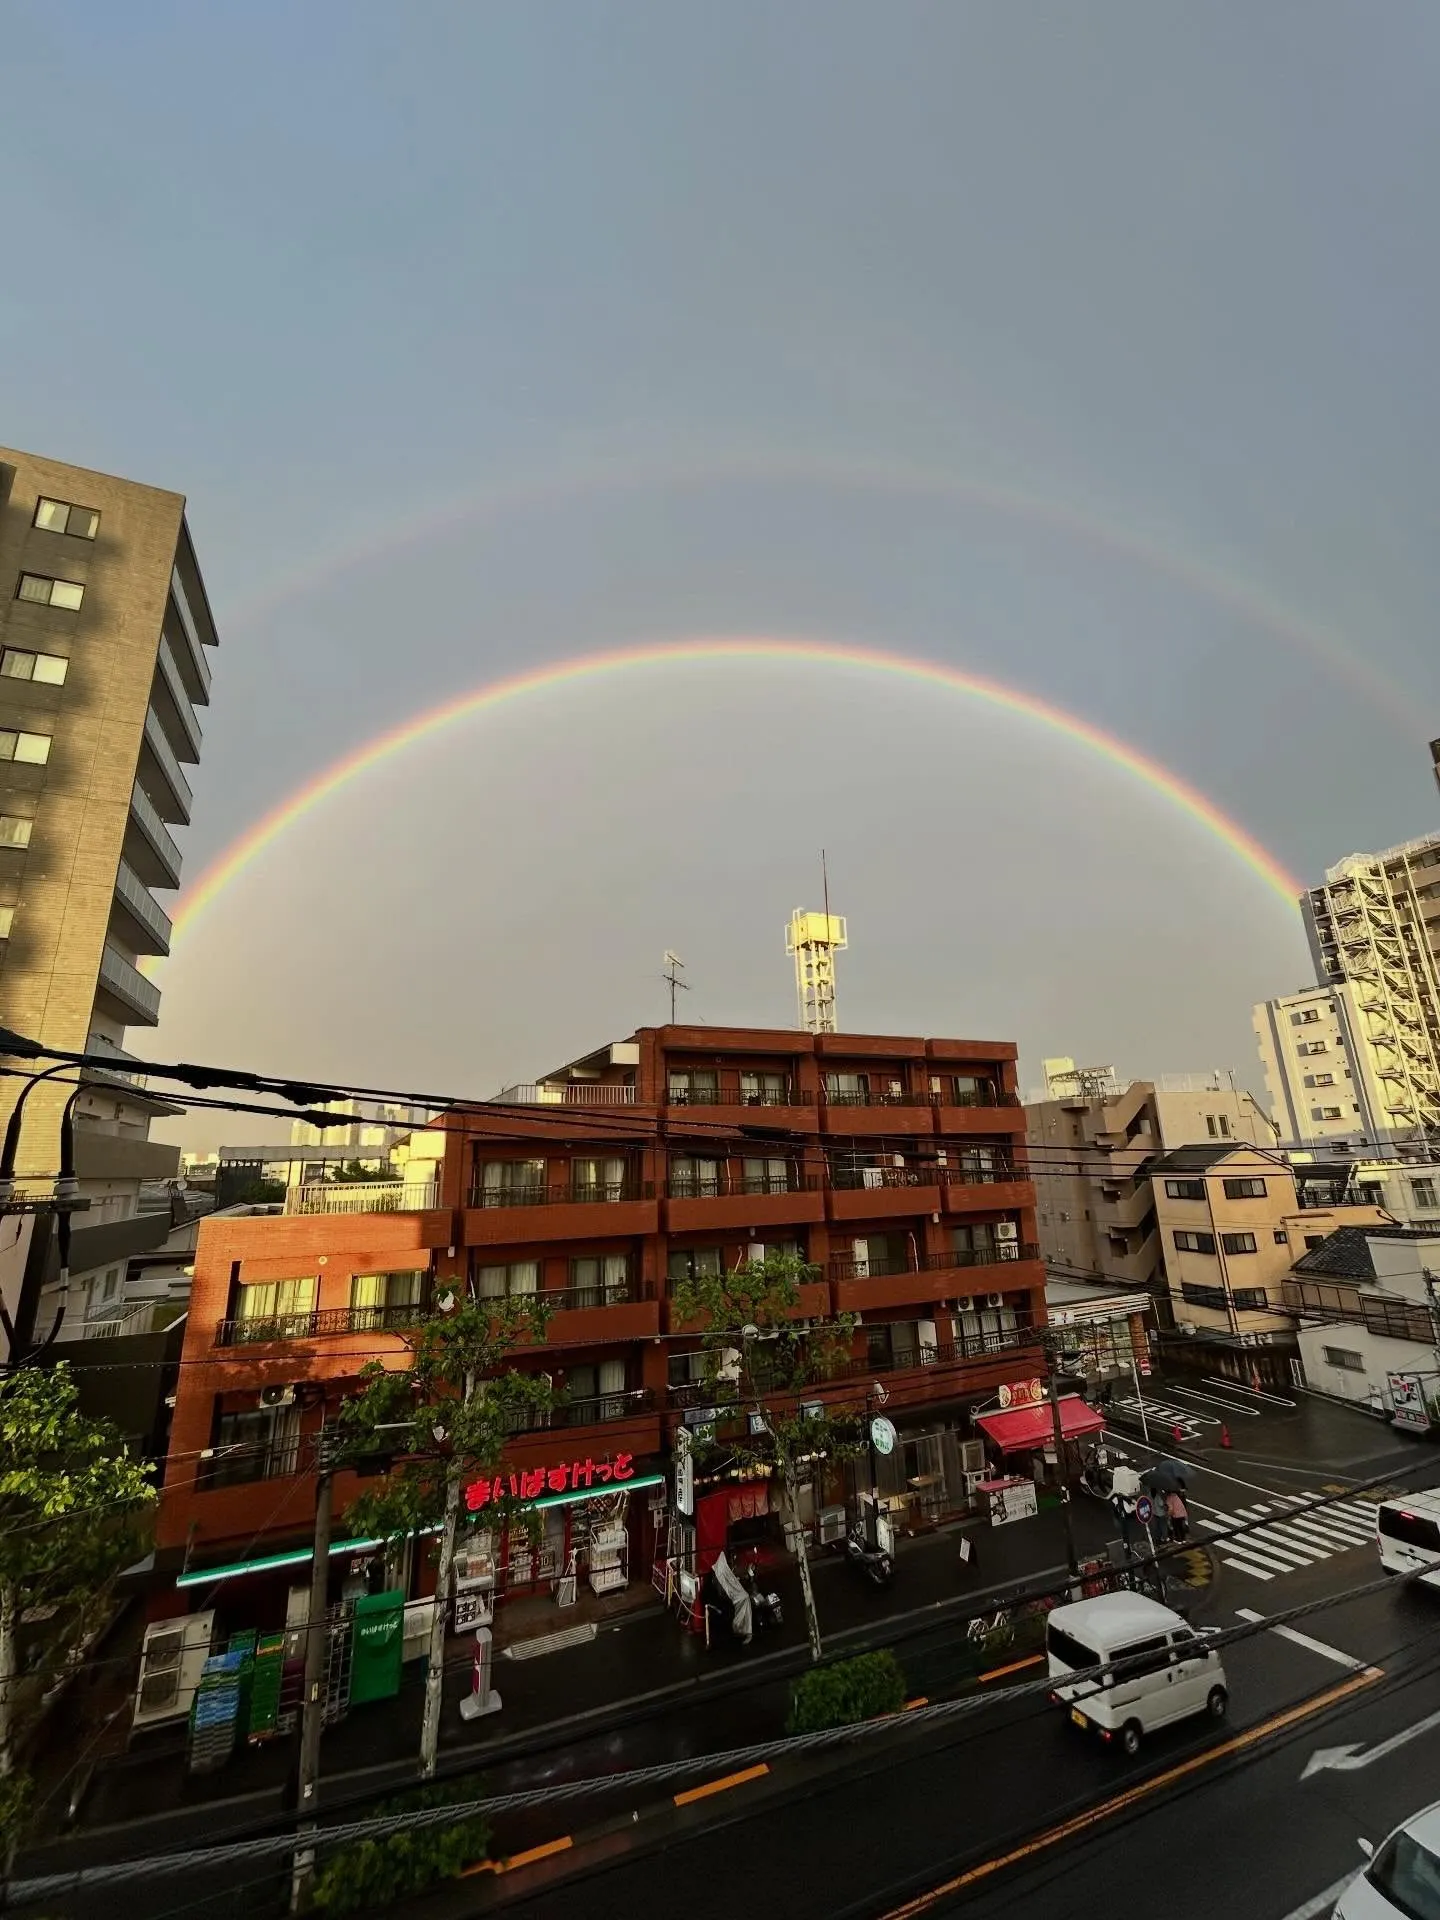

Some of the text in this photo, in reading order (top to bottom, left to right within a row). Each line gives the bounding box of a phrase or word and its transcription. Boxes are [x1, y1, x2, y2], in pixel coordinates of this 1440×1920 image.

[464, 1453, 635, 1511] まいばすけっと
